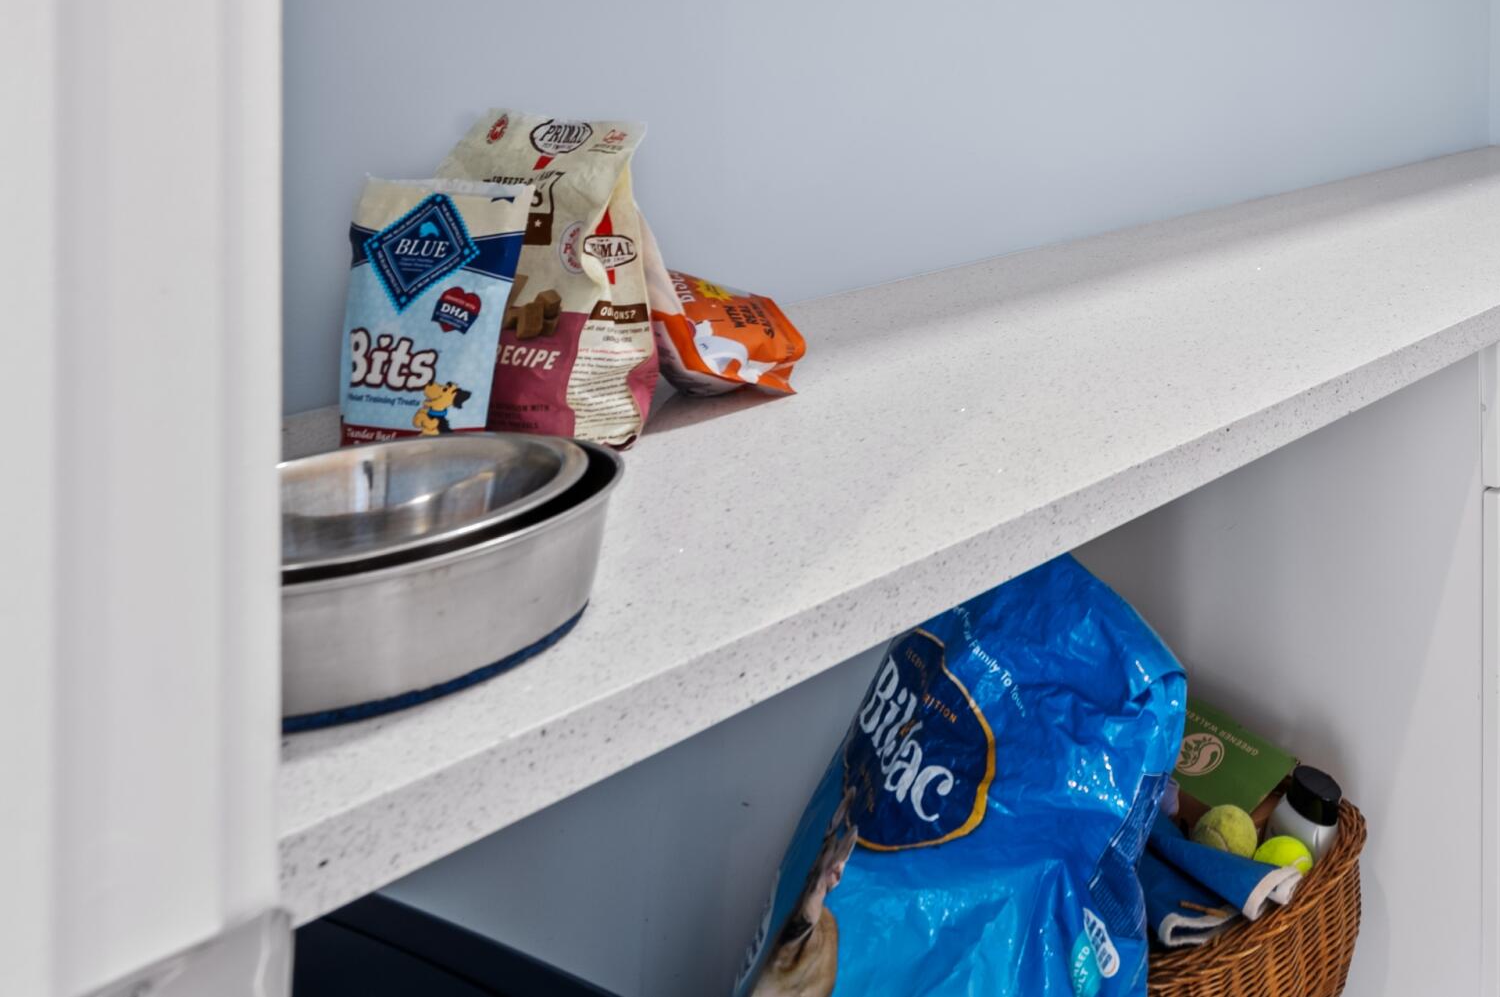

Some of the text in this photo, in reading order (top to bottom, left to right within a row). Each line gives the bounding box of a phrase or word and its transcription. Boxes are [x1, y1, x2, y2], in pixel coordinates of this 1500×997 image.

[539, 124, 587, 143] PRIMAL
[395, 238, 450, 258] BLUE
[441, 303, 469, 321] DHA
[350, 327, 439, 392] Bits
[365, 394, 396, 406] Training
[397, 398, 420, 406] Treats
[346, 428, 374, 439] Tender
[969, 640, 1026, 718] Family To Yours
